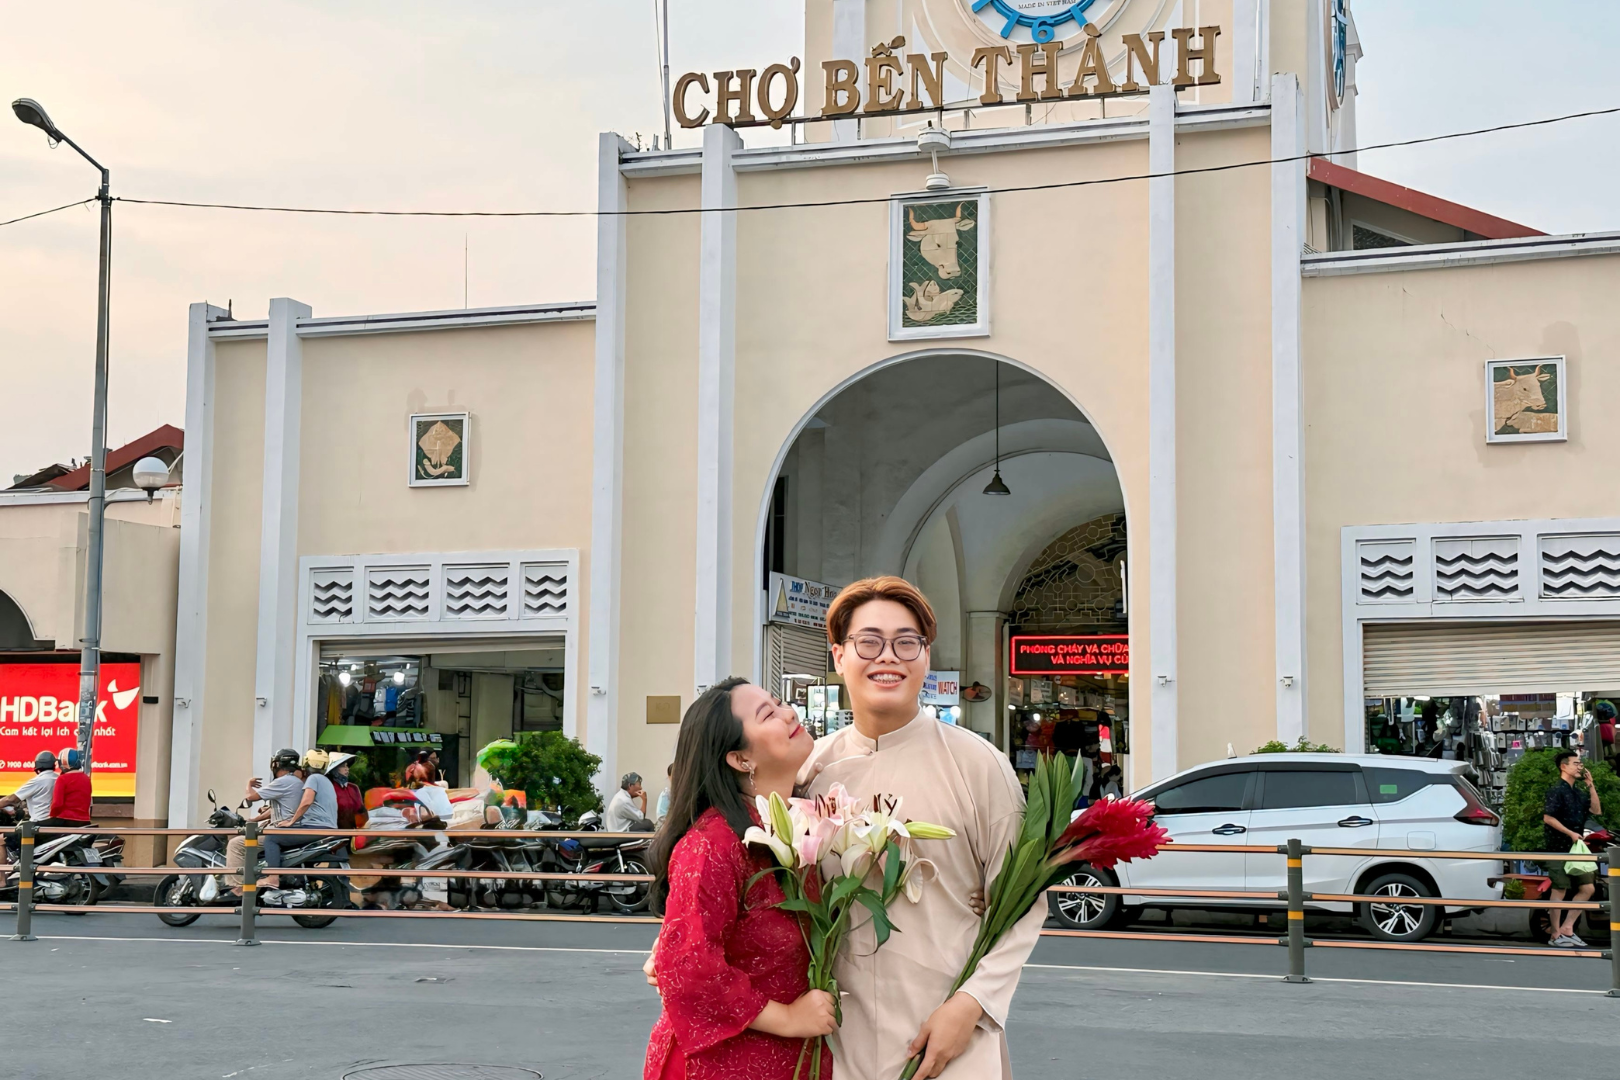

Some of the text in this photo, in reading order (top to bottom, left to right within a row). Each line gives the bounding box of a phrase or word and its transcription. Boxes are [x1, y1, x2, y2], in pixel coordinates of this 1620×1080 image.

[1031, 16, 1055, 44] 6
[672, 24, 1221, 129] CHỢ BẾN THÀNH
[938, 681, 957, 695] WATCH
[0, 696, 108, 722] HDBak
[0, 726, 18, 736] Cam
